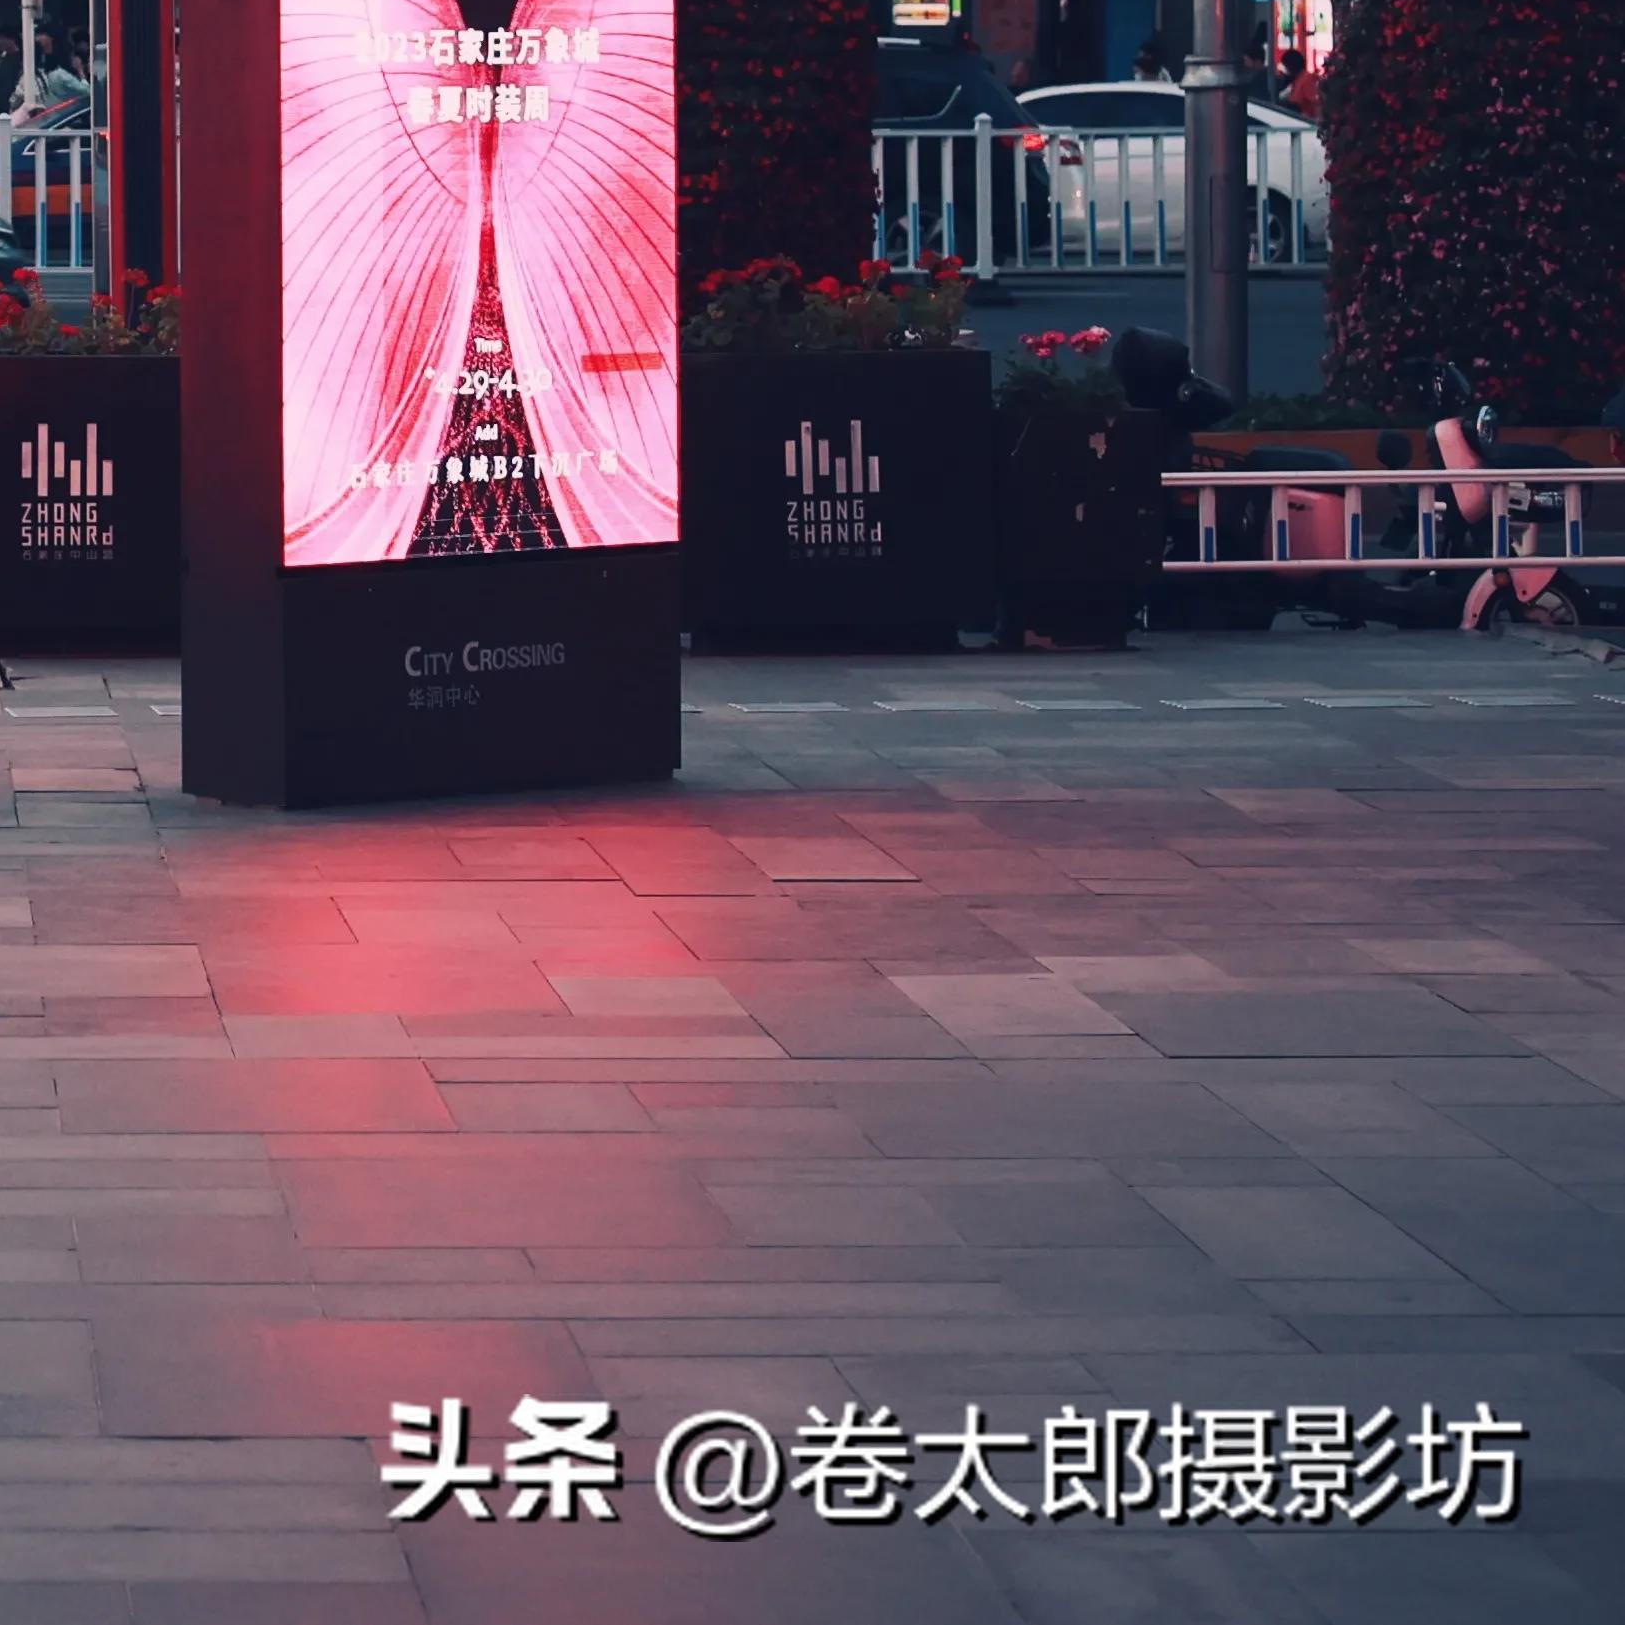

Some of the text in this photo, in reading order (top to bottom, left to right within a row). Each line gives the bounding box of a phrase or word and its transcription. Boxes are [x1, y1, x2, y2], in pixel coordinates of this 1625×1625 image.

[353, 26, 600, 67] 2023石家庄万象城
[406, 85, 550, 125] 春夏时装周
[475, 424, 499, 441] Add
[21, 503, 98, 523] ZHONG
[787, 500, 865, 521] ZHONG
